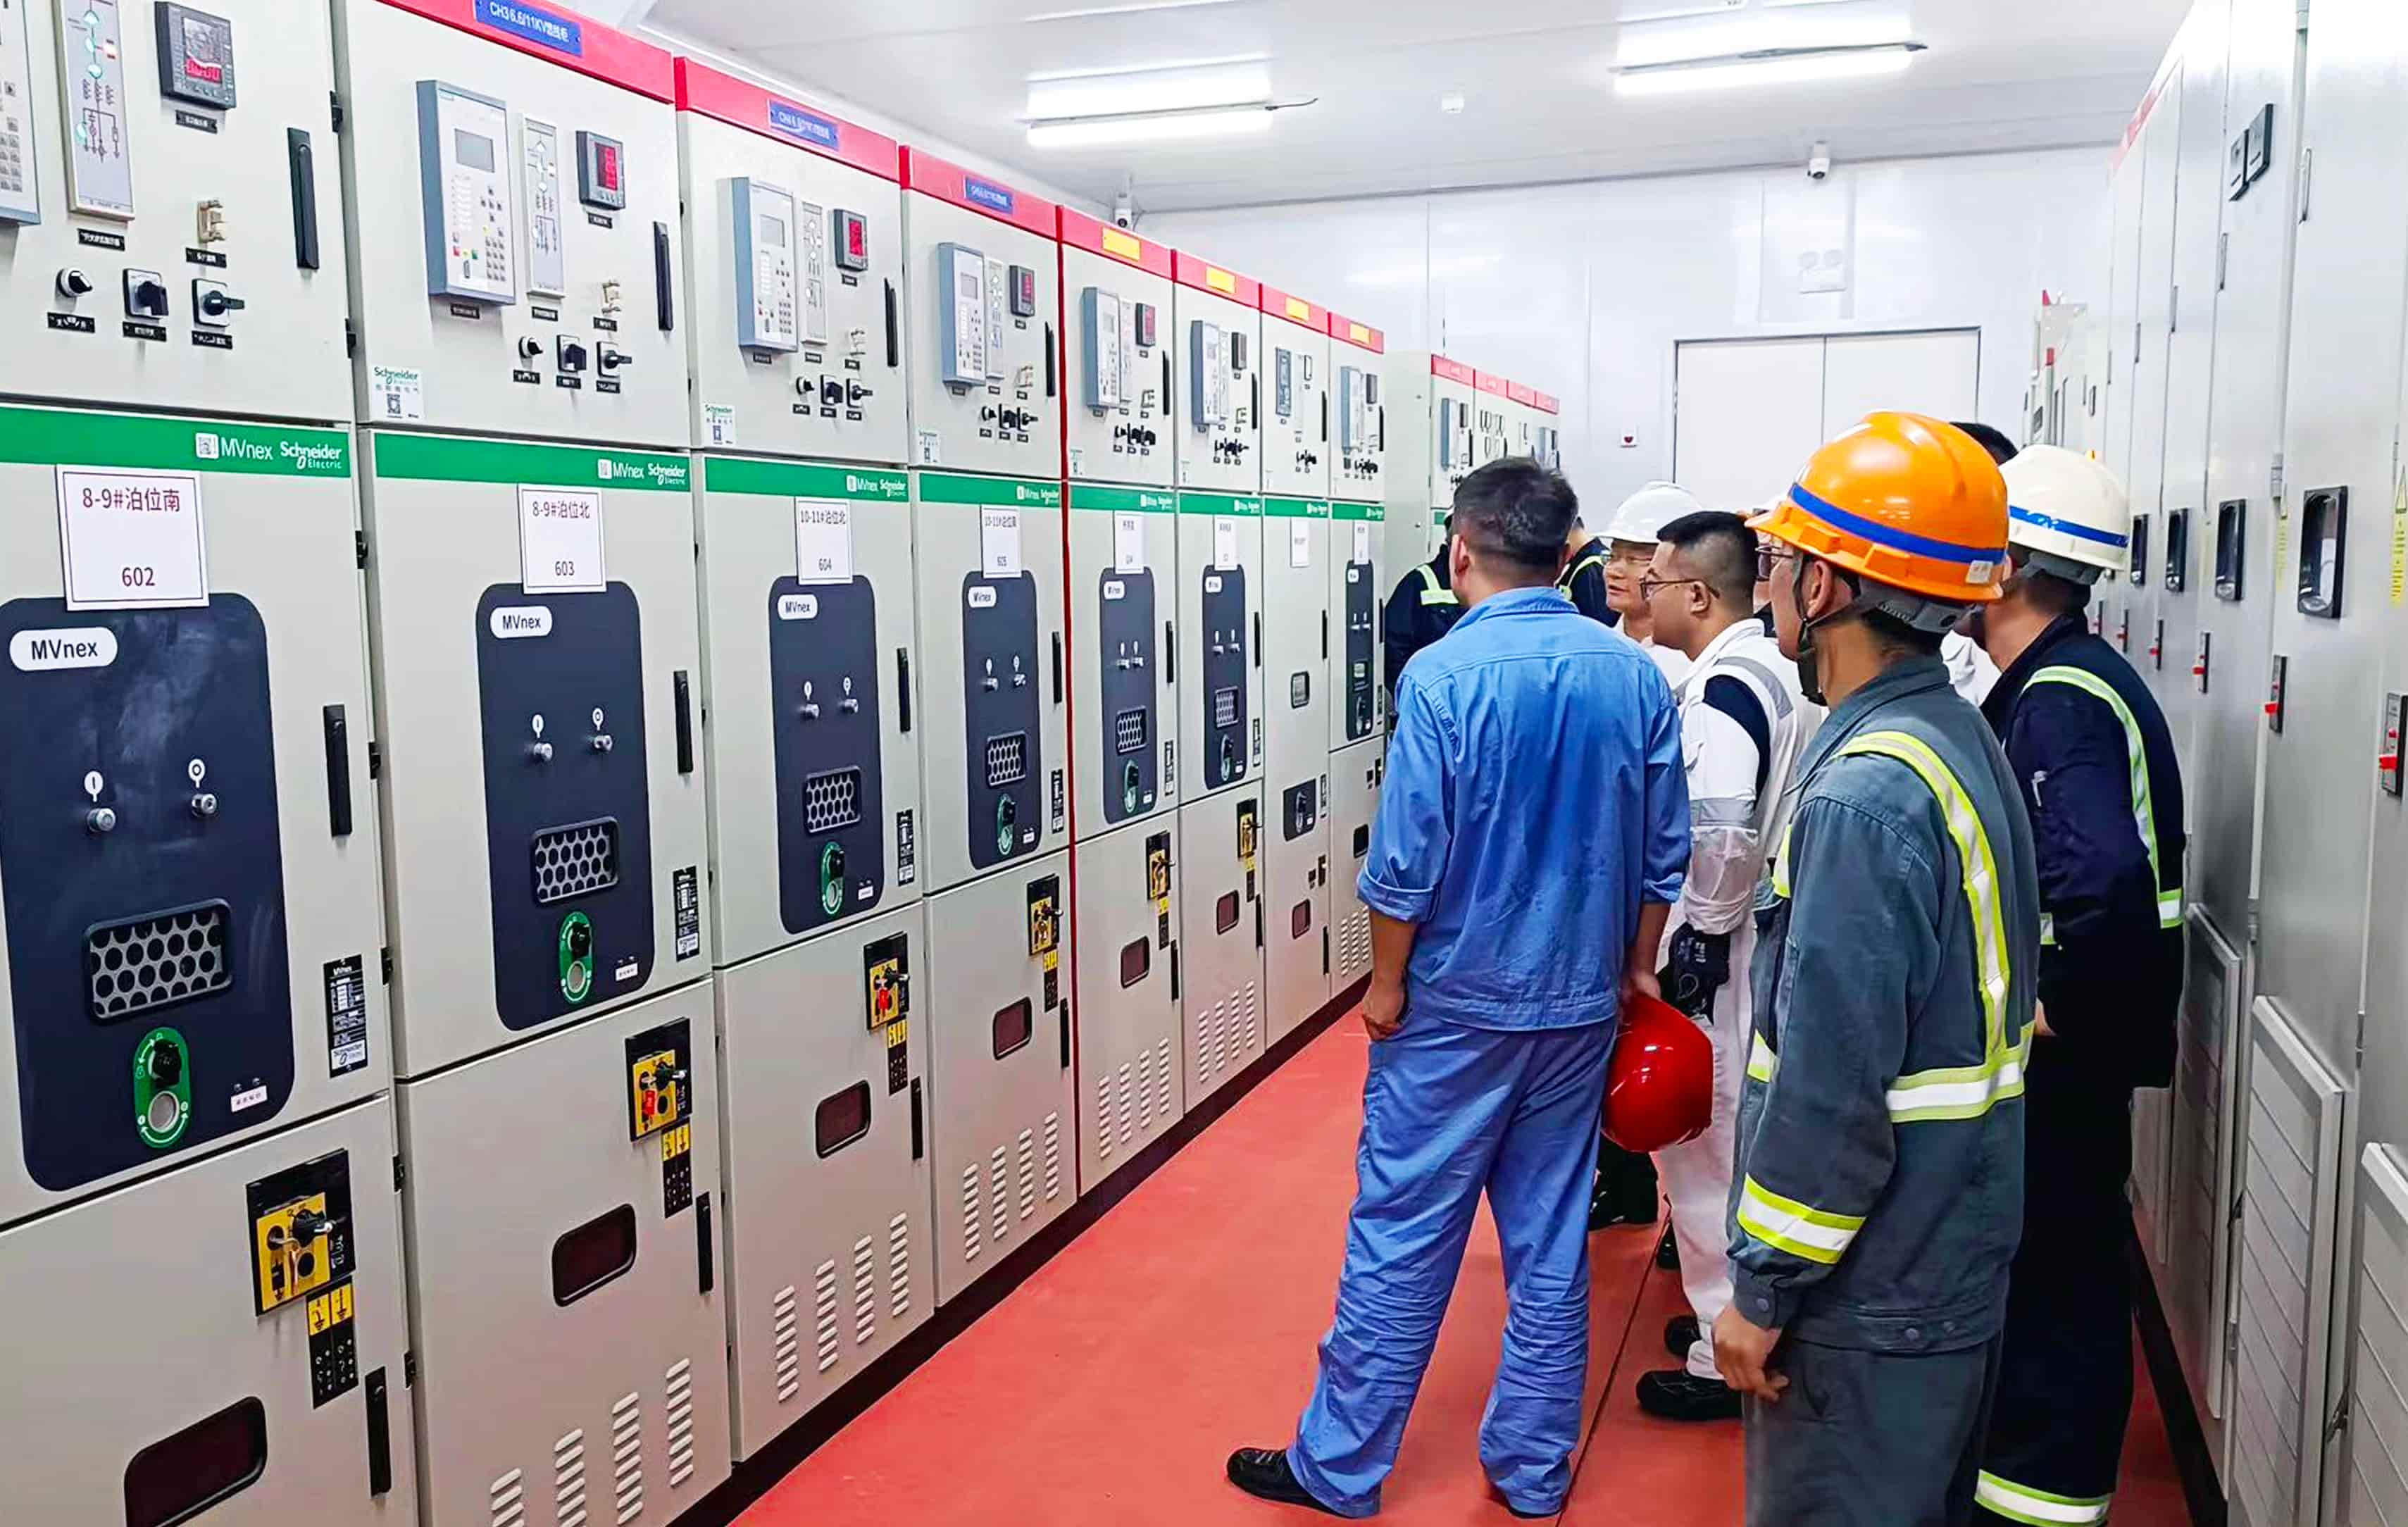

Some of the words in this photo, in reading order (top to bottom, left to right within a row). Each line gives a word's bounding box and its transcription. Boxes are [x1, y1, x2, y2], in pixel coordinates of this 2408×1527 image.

[220, 437, 273, 461] MVnex
[280, 441, 342, 469] Schneider
[308, 459, 342, 469] Electric
[613, 461, 644, 479] MVnex
[647, 462, 686, 485] Schneider
[82, 487, 180, 512] 8-9#泊位南
[532, 501, 590, 518] 8-9#泊位北
[122, 566, 156, 587] 602
[554, 561, 575, 576] 603
[502, 614, 542, 630] MVnex
[31, 637, 99, 660] MVnex
